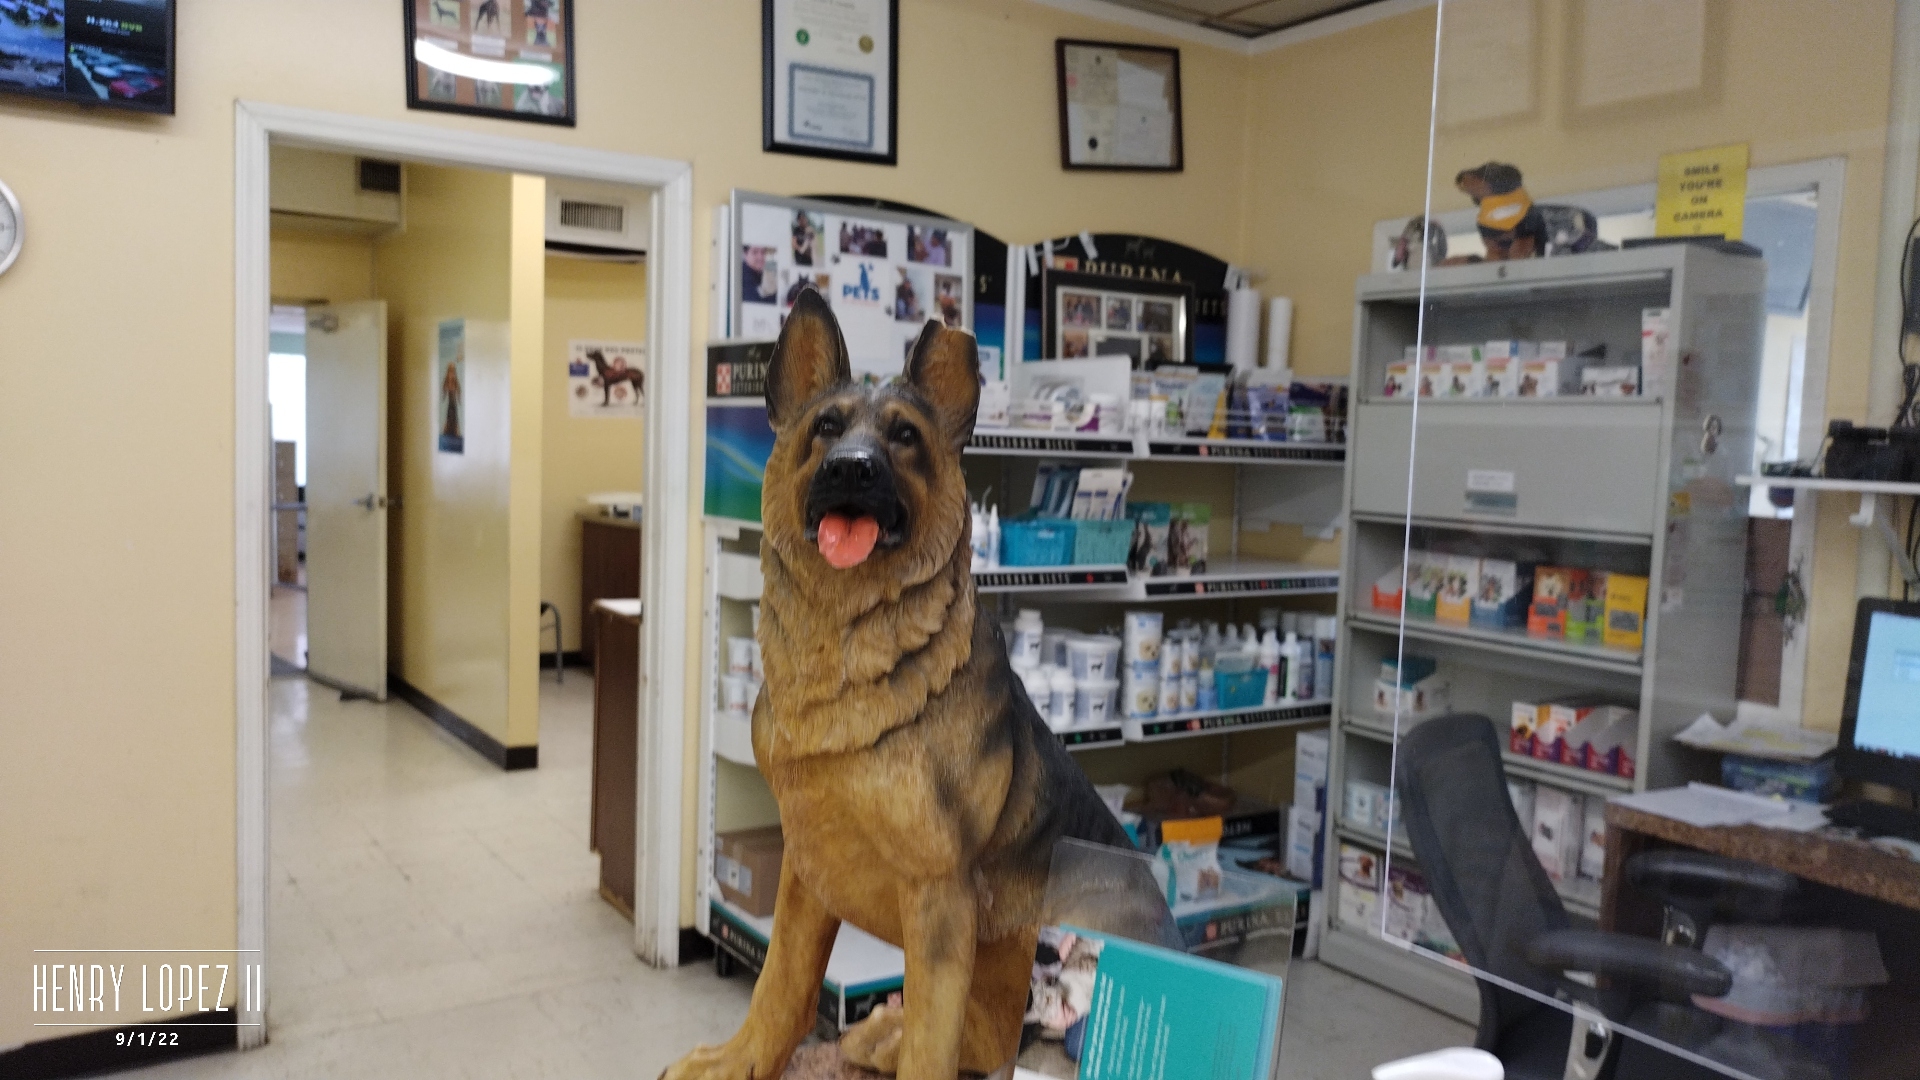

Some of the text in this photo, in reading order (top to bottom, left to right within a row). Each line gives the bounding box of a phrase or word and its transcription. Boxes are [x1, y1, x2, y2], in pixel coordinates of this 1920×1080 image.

[1684, 164, 1719, 176] SMILE
[1680, 179, 1723, 192] YOU'RE
[1691, 195, 1708, 205] ON
[1674, 209, 1723, 222] CAMERA
